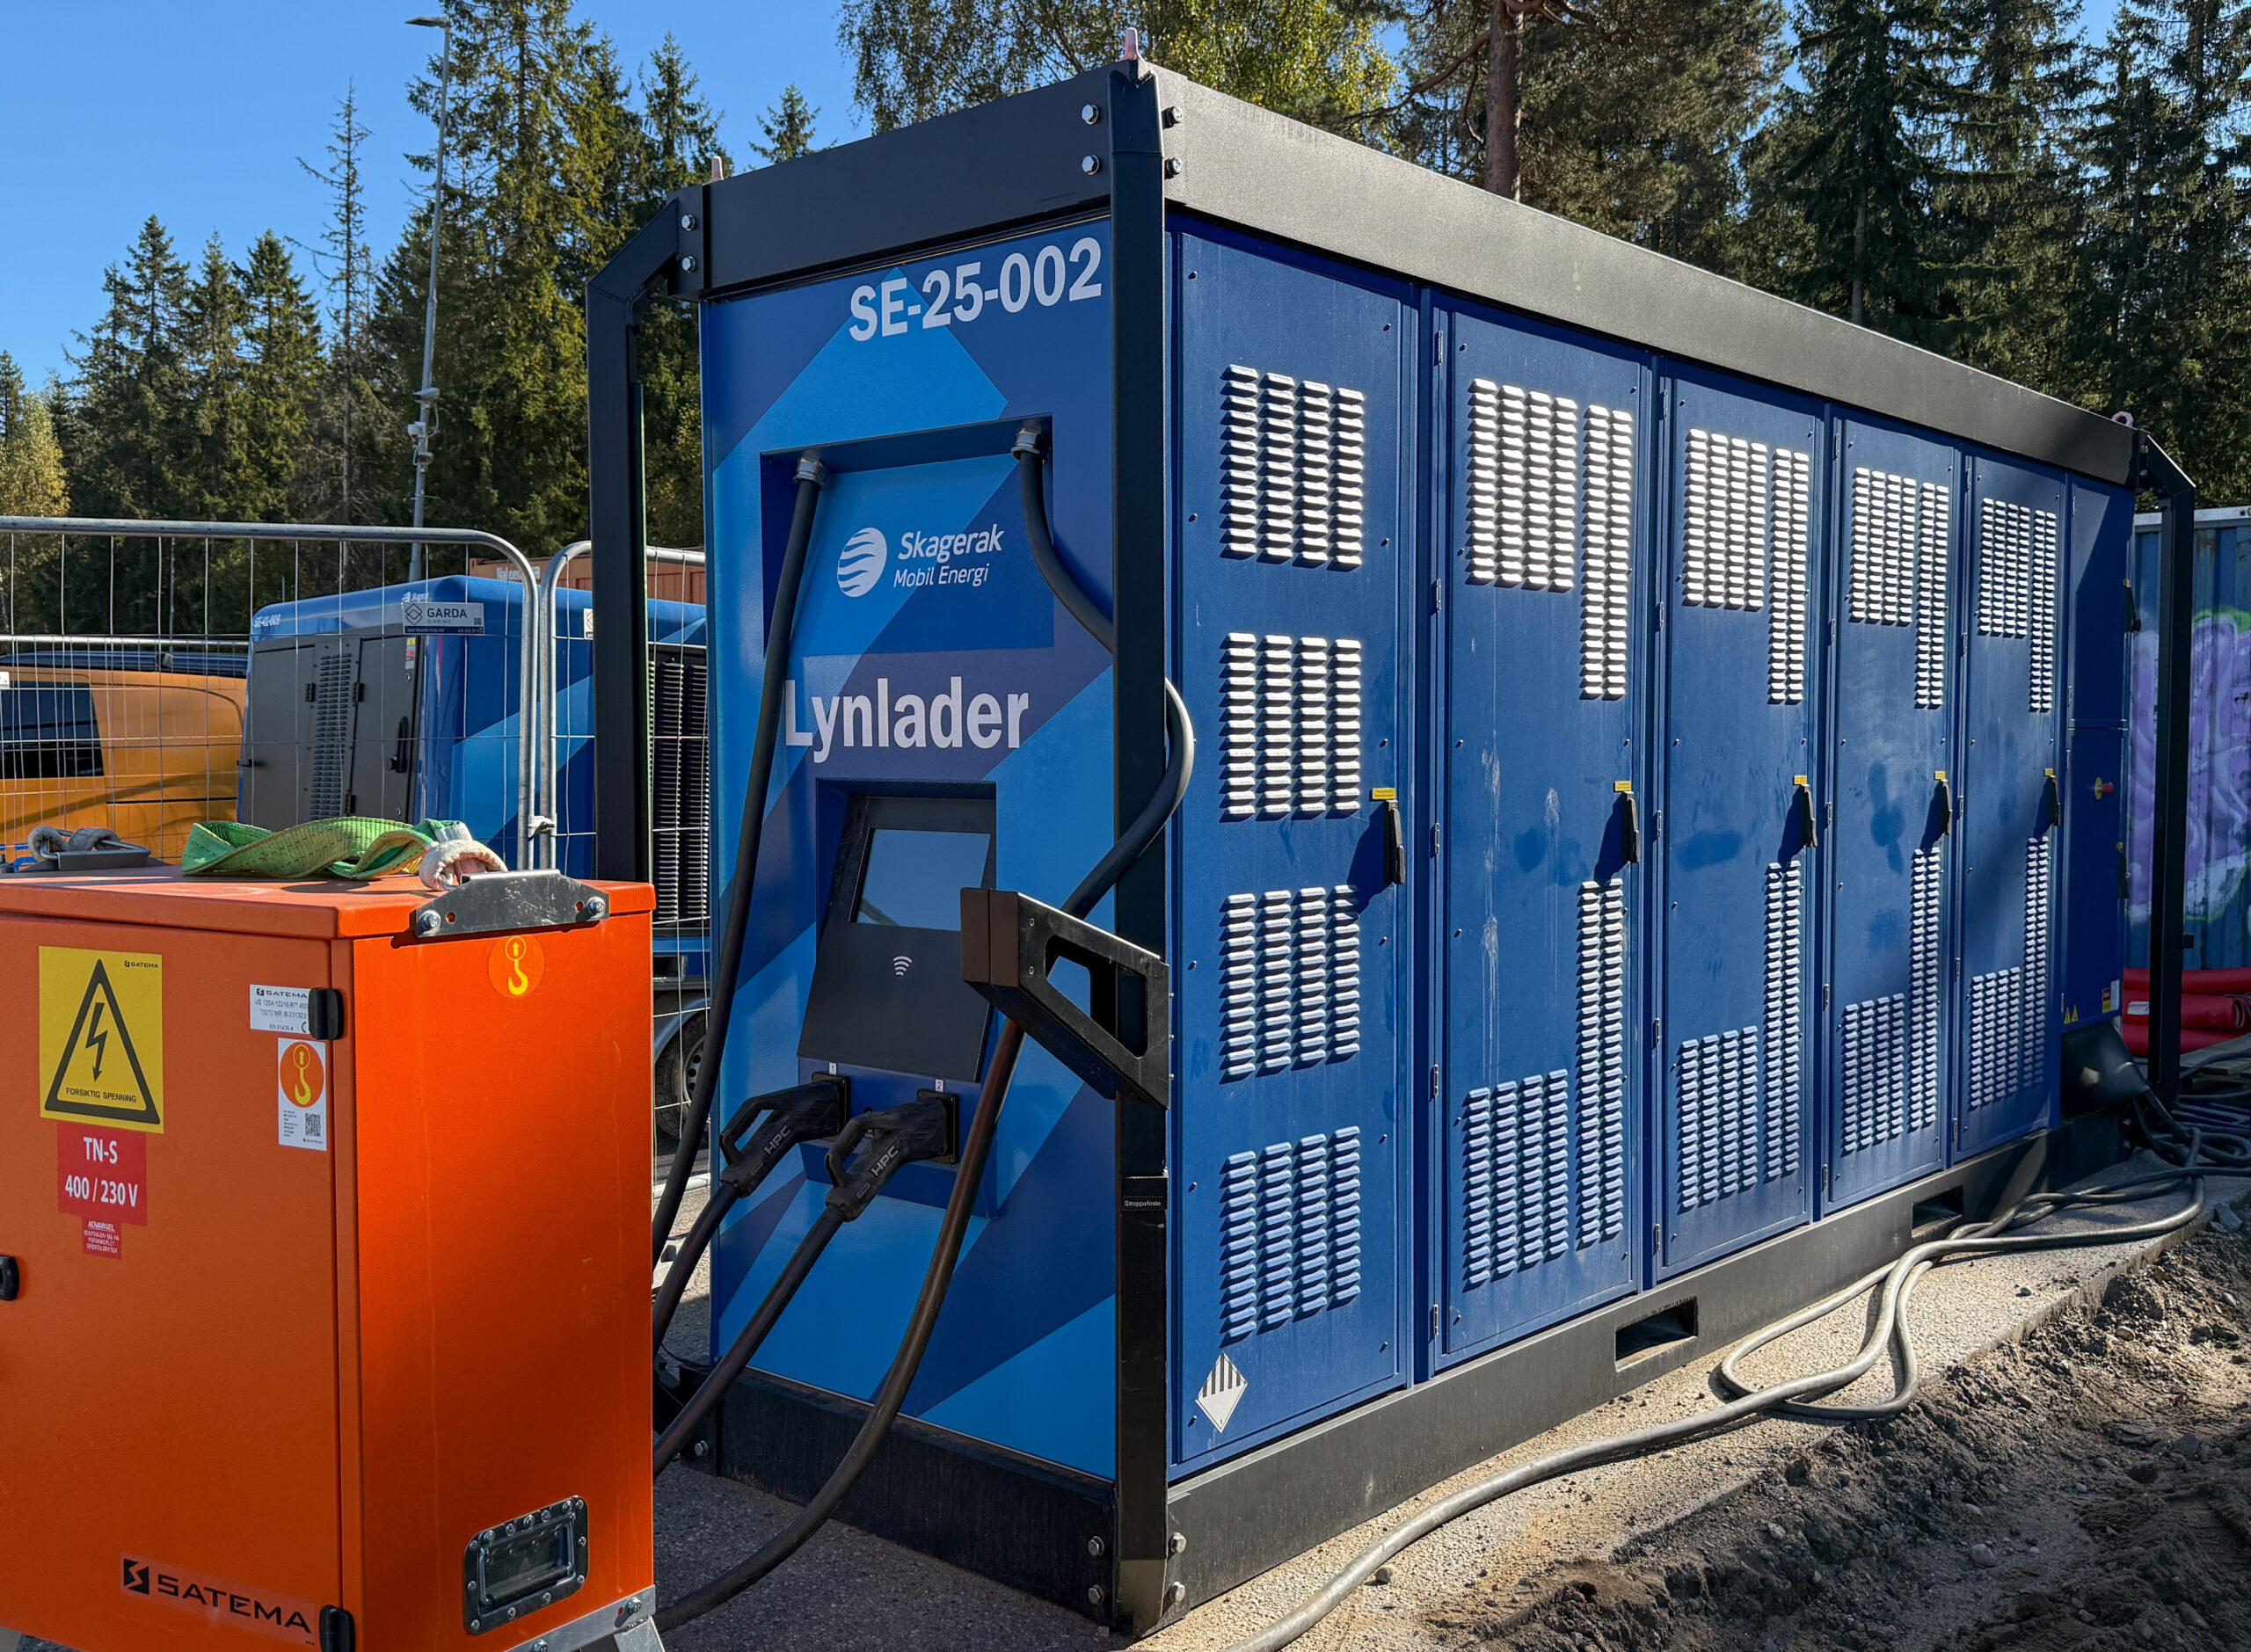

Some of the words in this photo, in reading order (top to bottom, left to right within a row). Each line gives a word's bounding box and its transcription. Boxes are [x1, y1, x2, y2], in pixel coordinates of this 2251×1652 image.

[849, 237, 1102, 342] SE-25-002
[898, 523, 1005, 564] Skagerak
[893, 566, 934, 588] Mobil
[938, 563, 990, 587] Energi
[428, 608, 467, 618] GARDA
[784, 675, 1030, 764] Lynlader
[66, 1087, 101, 1098] FORSIKTIG
[103, 1091, 137, 1103] SPENNING
[936, 1081, 942, 1090] 2
[83, 1136, 118, 1164] TN-S
[764, 1125, 792, 1156] HPC
[871, 1146, 900, 1177] HPC
[65, 1175, 90, 1200] 400
[92, 1177, 98, 1203] /
[100, 1180, 126, 1205] 230
[127, 1183, 138, 1207] V
[157, 1574, 312, 1634] SATEMA
